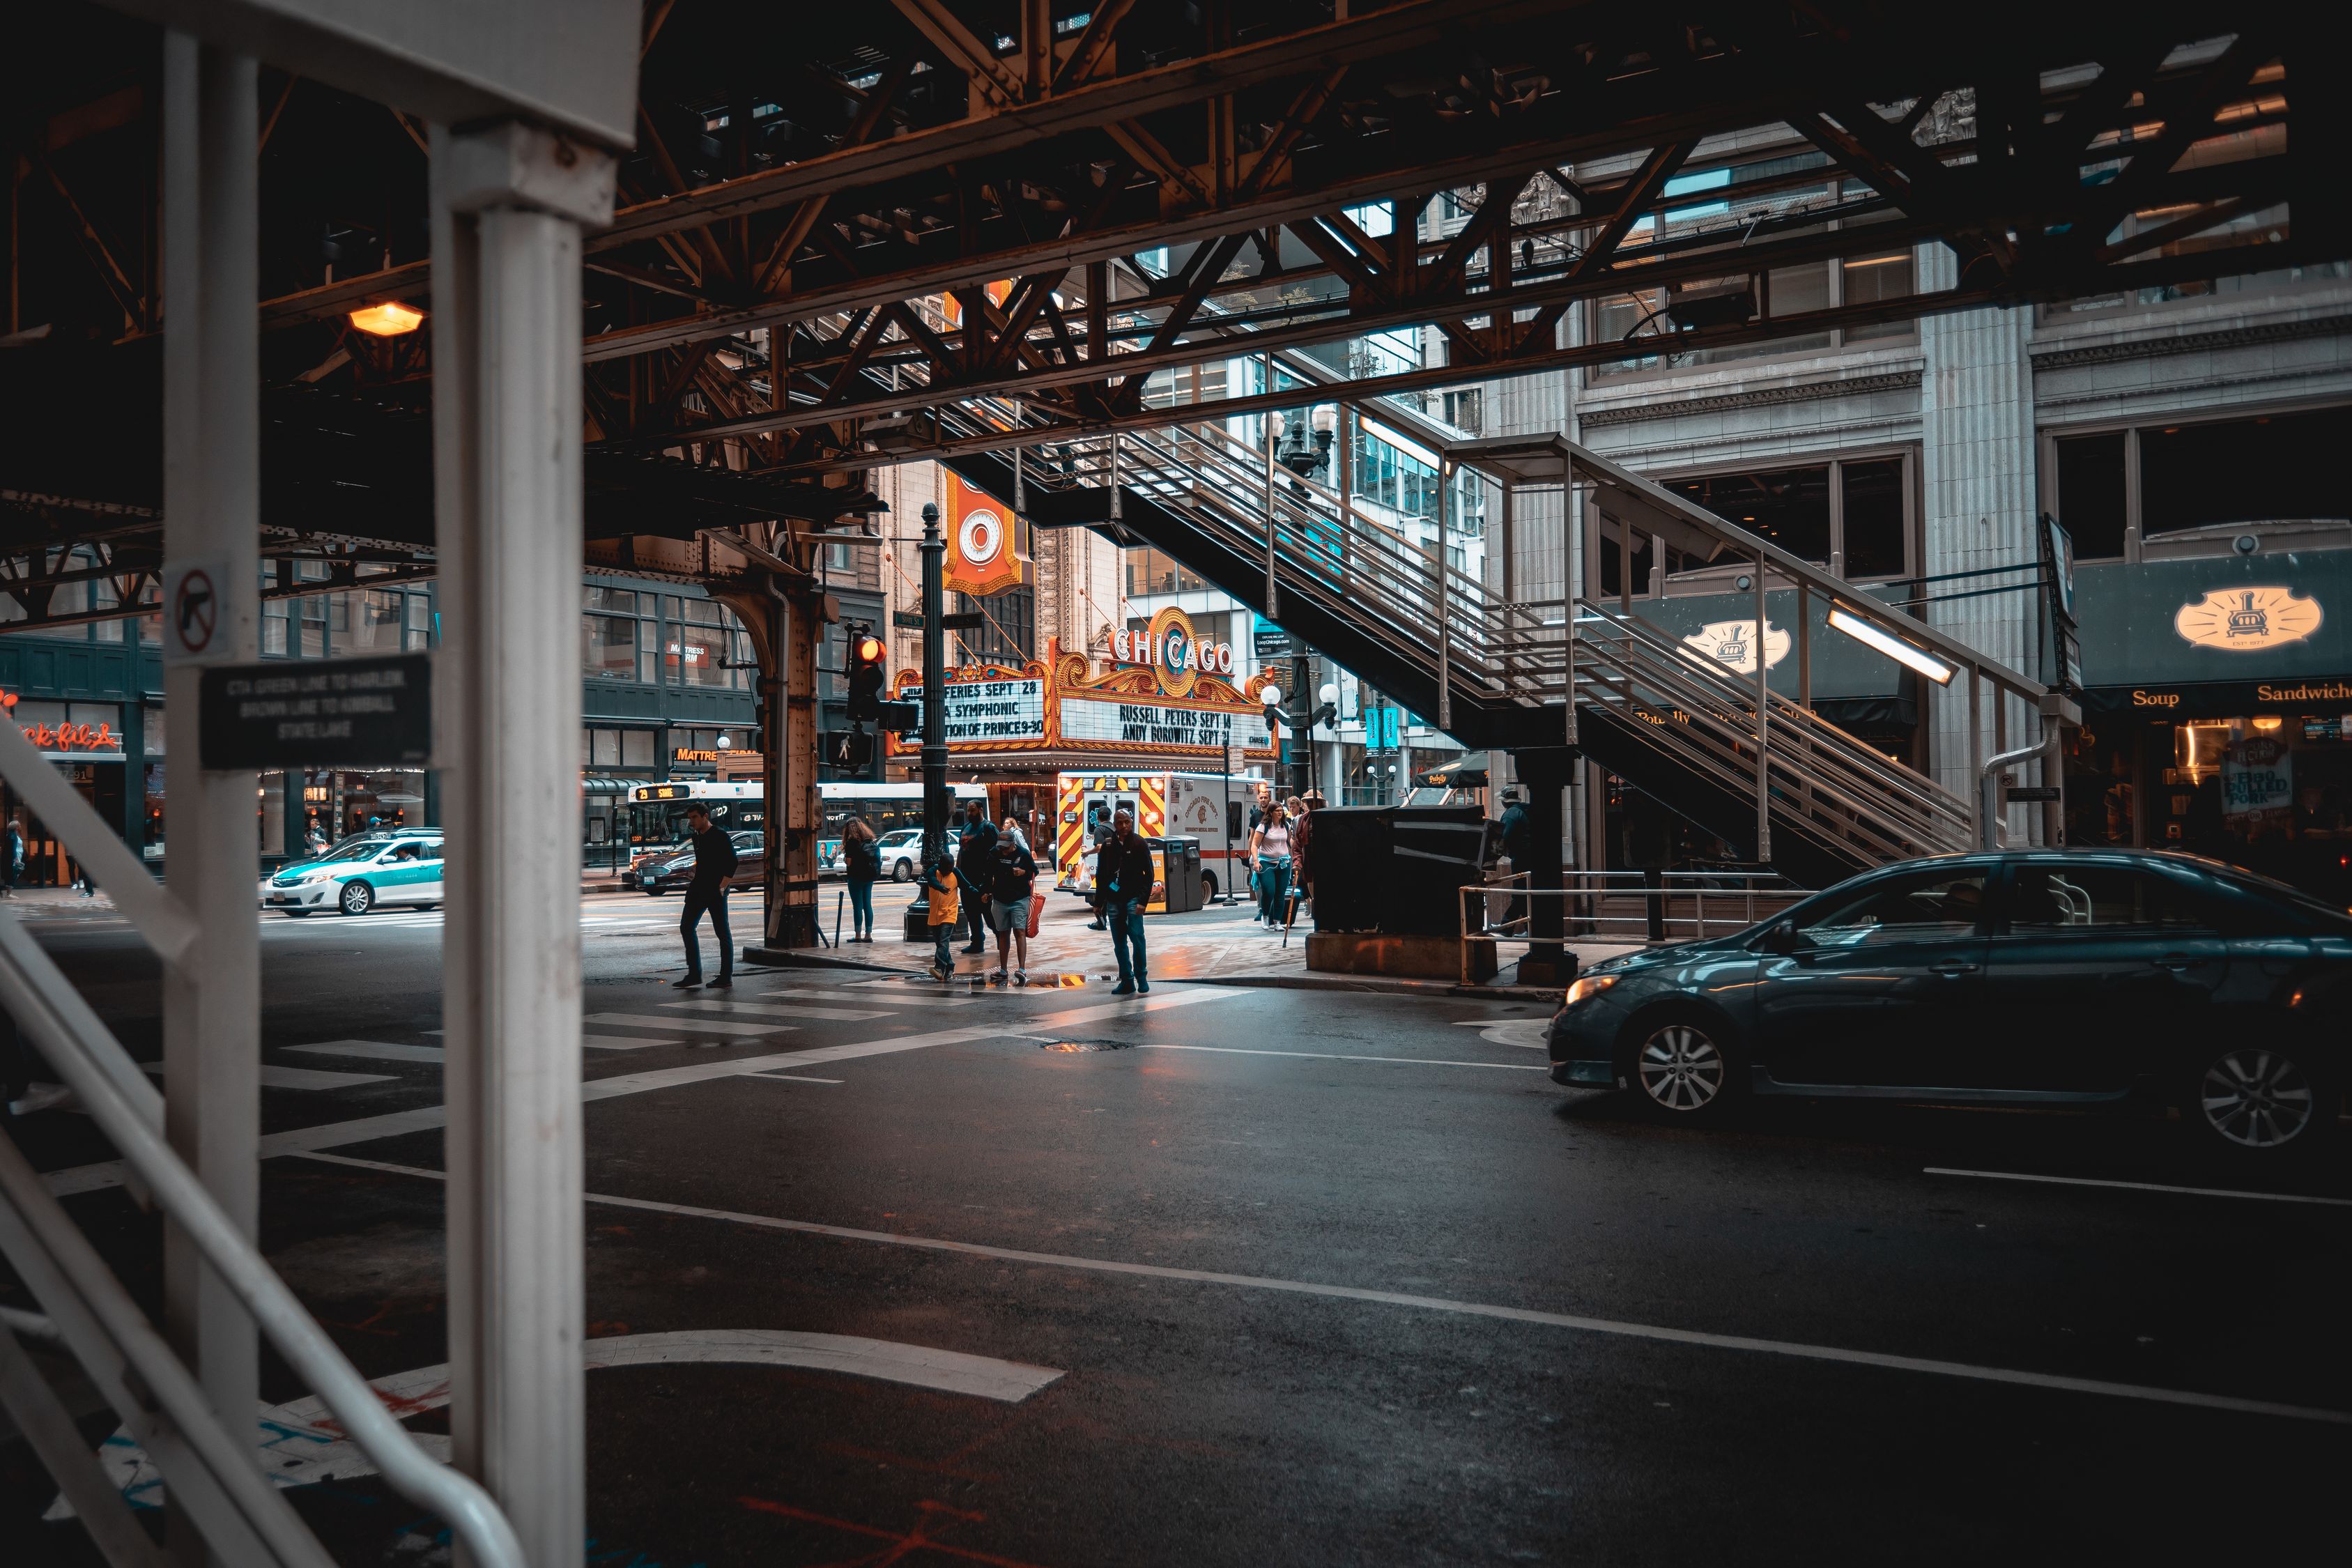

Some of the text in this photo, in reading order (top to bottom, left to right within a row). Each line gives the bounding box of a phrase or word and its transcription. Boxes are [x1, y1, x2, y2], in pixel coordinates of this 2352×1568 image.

[1114, 627, 1233, 673] CHICAGO
[944, 684, 981, 699] FERIES
[985, 682, 1013, 697] SEPT
[1022, 681, 1037, 695] 28
[2132, 690, 2180, 708] Soup
[955, 701, 1018, 718] SYMPHONIC
[1119, 705, 1231, 729] RUSSELL PETERS SEPT 14
[969, 723, 981, 737] OF
[1122, 723, 1147, 741] ANDY
[1151, 725, 1196, 744] BOROWITZ
[1199, 728, 1220, 746] SEPT
[677, 748, 717, 762] MATTRE
[638, 787, 674, 799] 29 STATE
[2224, 778, 2288, 797] PULLED
[1185, 796, 1200, 818] CHICAGO
[1201, 795, 1210, 805] FIRE
[2229, 791, 2270, 805] PORK
